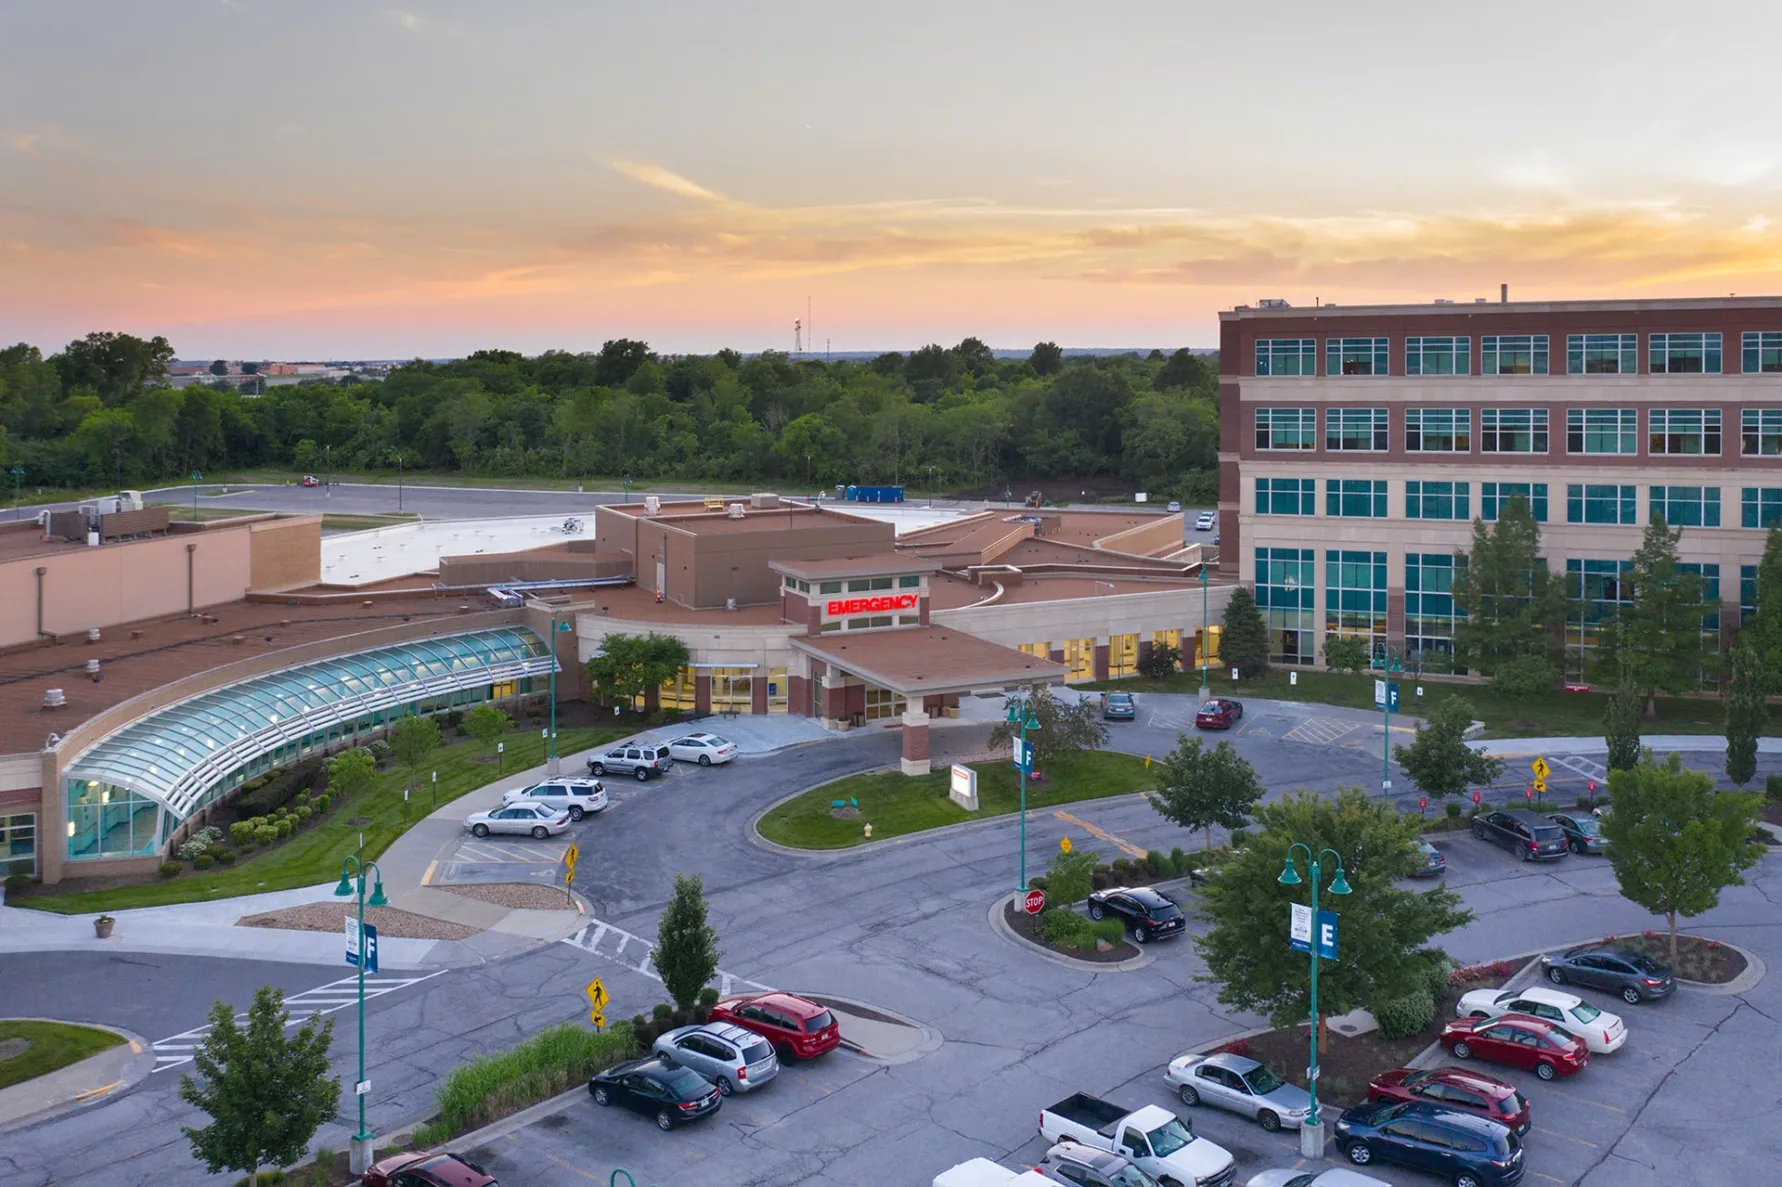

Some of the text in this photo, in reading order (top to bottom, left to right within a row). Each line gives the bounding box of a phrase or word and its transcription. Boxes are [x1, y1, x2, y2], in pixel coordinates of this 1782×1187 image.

[828, 594, 918, 615] EMERGENCY
[1390, 691, 1397, 705] F
[1025, 750, 1032, 765] F
[1026, 896, 1044, 908] STOP
[1321, 923, 1334, 947] E
[367, 936, 375, 958] F
